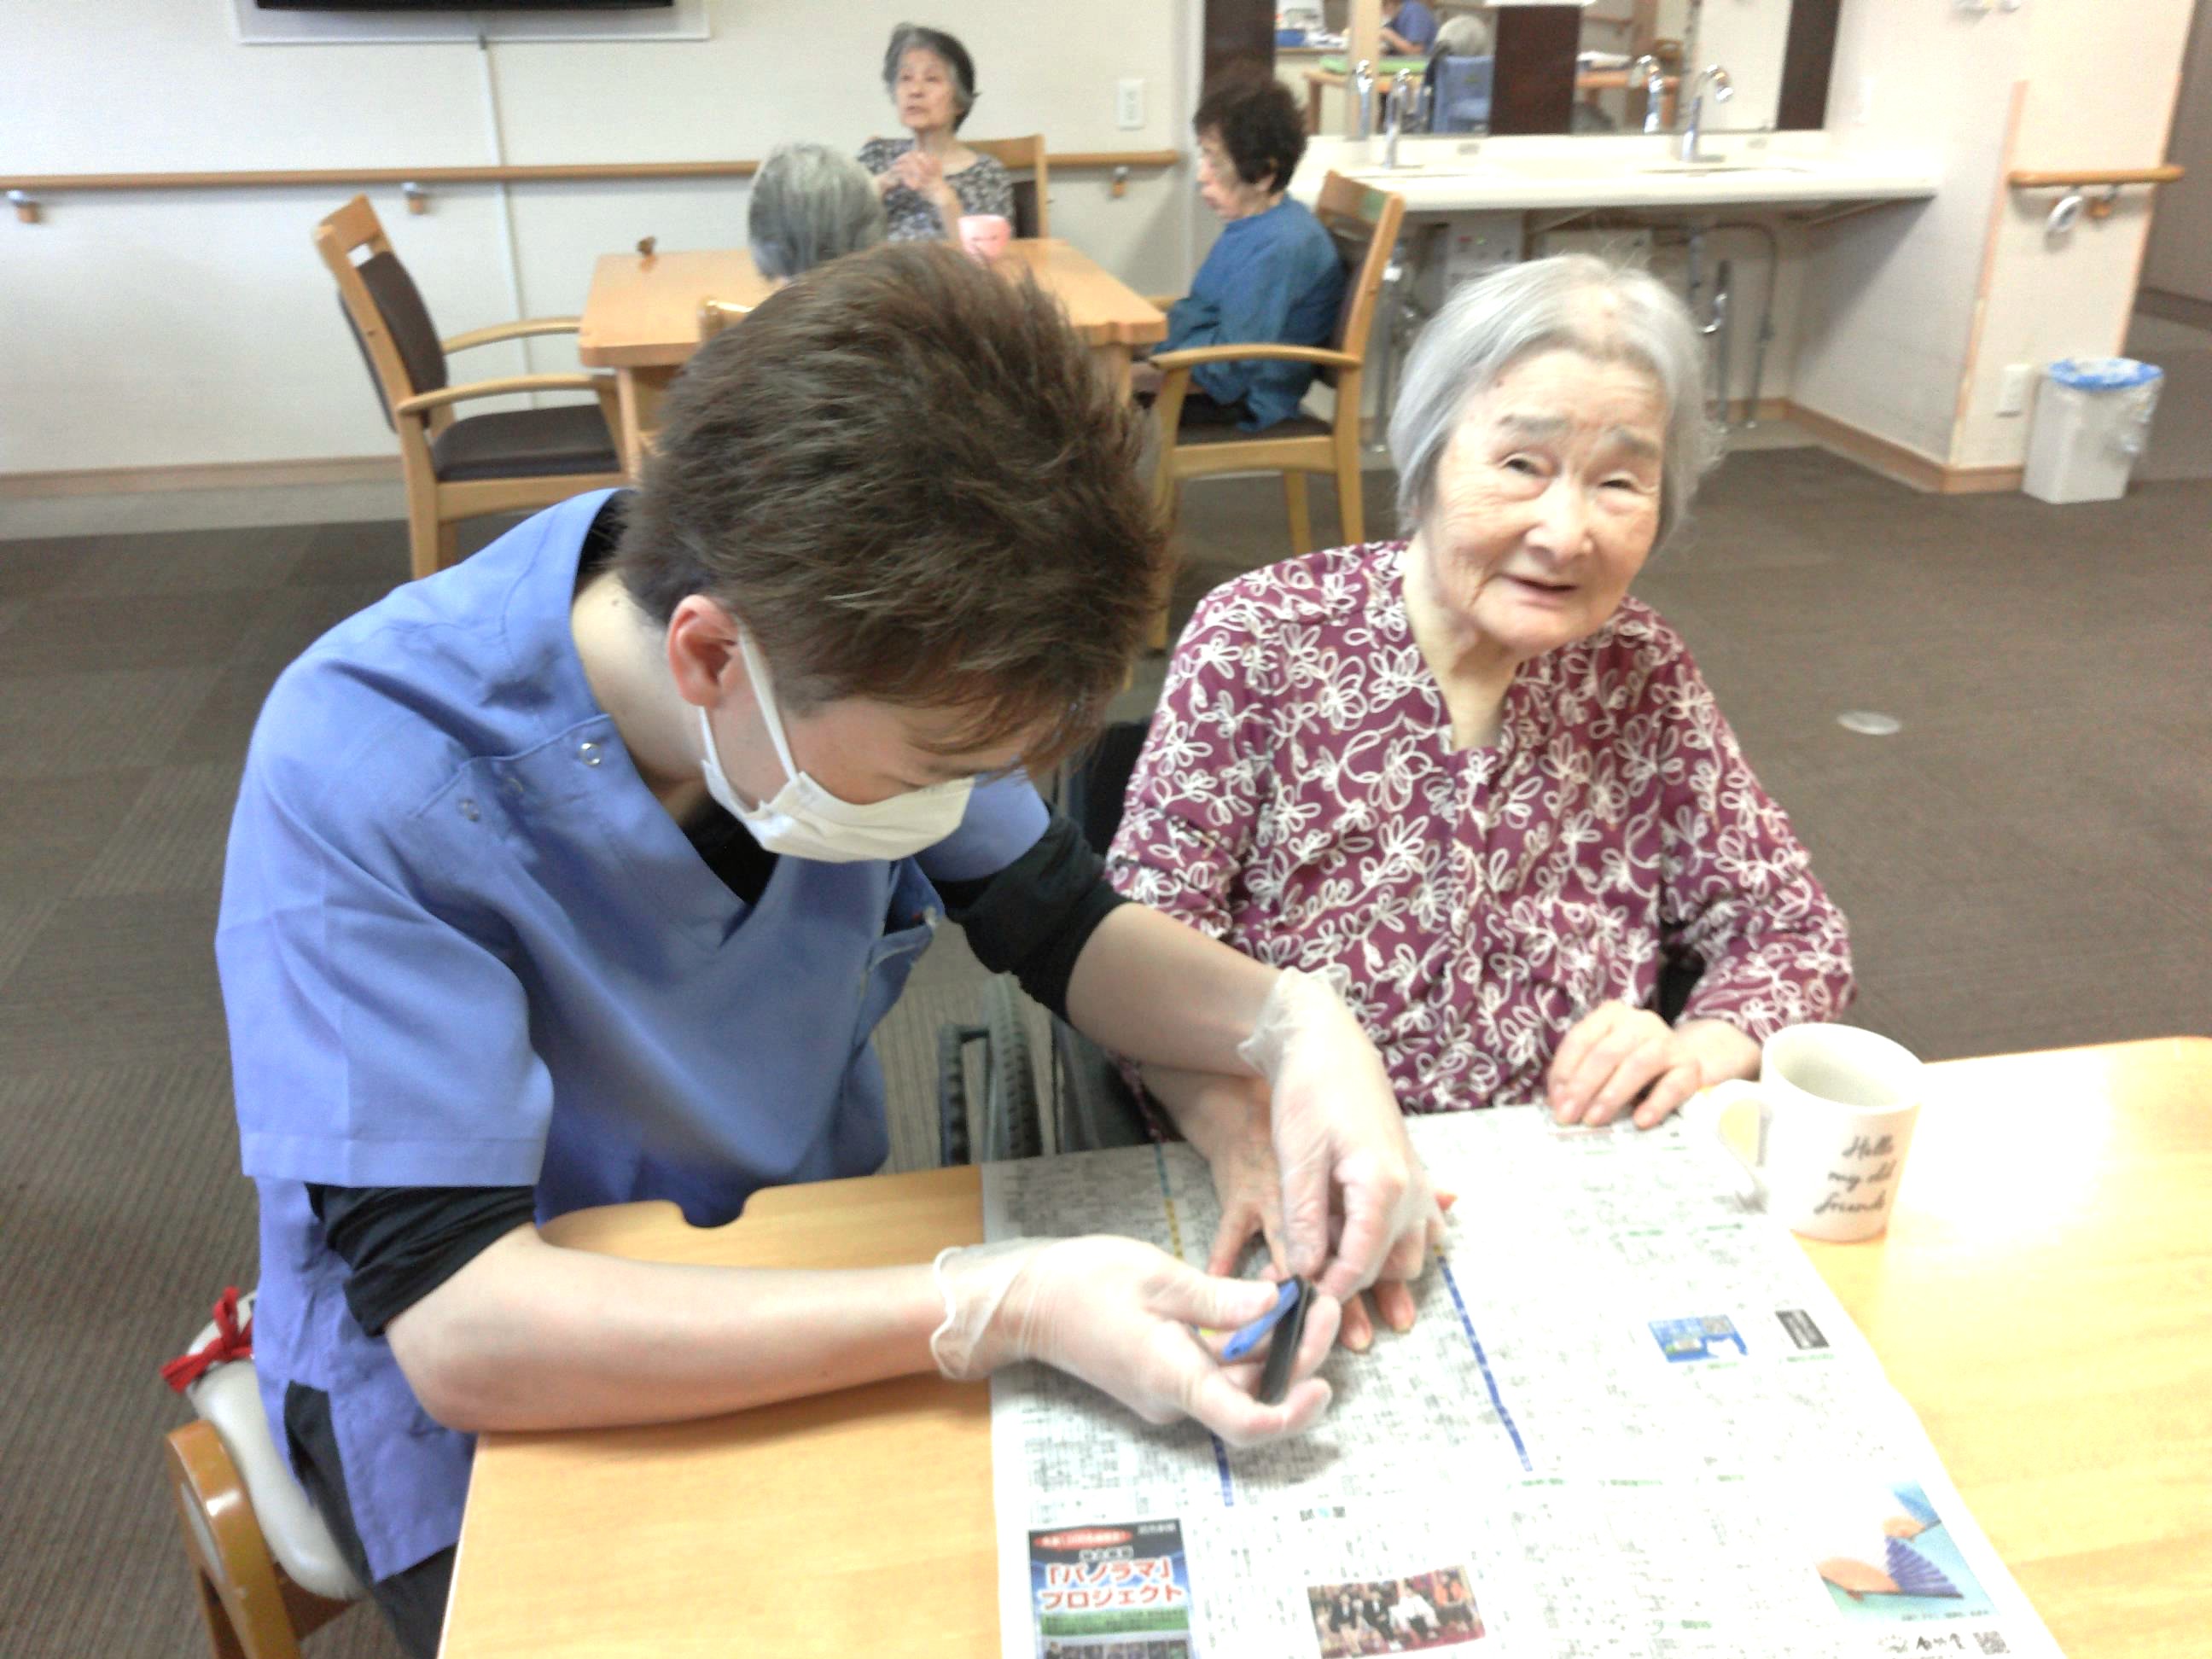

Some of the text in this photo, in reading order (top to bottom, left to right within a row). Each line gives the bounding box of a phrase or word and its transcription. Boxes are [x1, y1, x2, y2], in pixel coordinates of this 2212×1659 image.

[1827, 1171, 1861, 1193] my
[1041, 1584, 1183, 1610] プロジェクト
